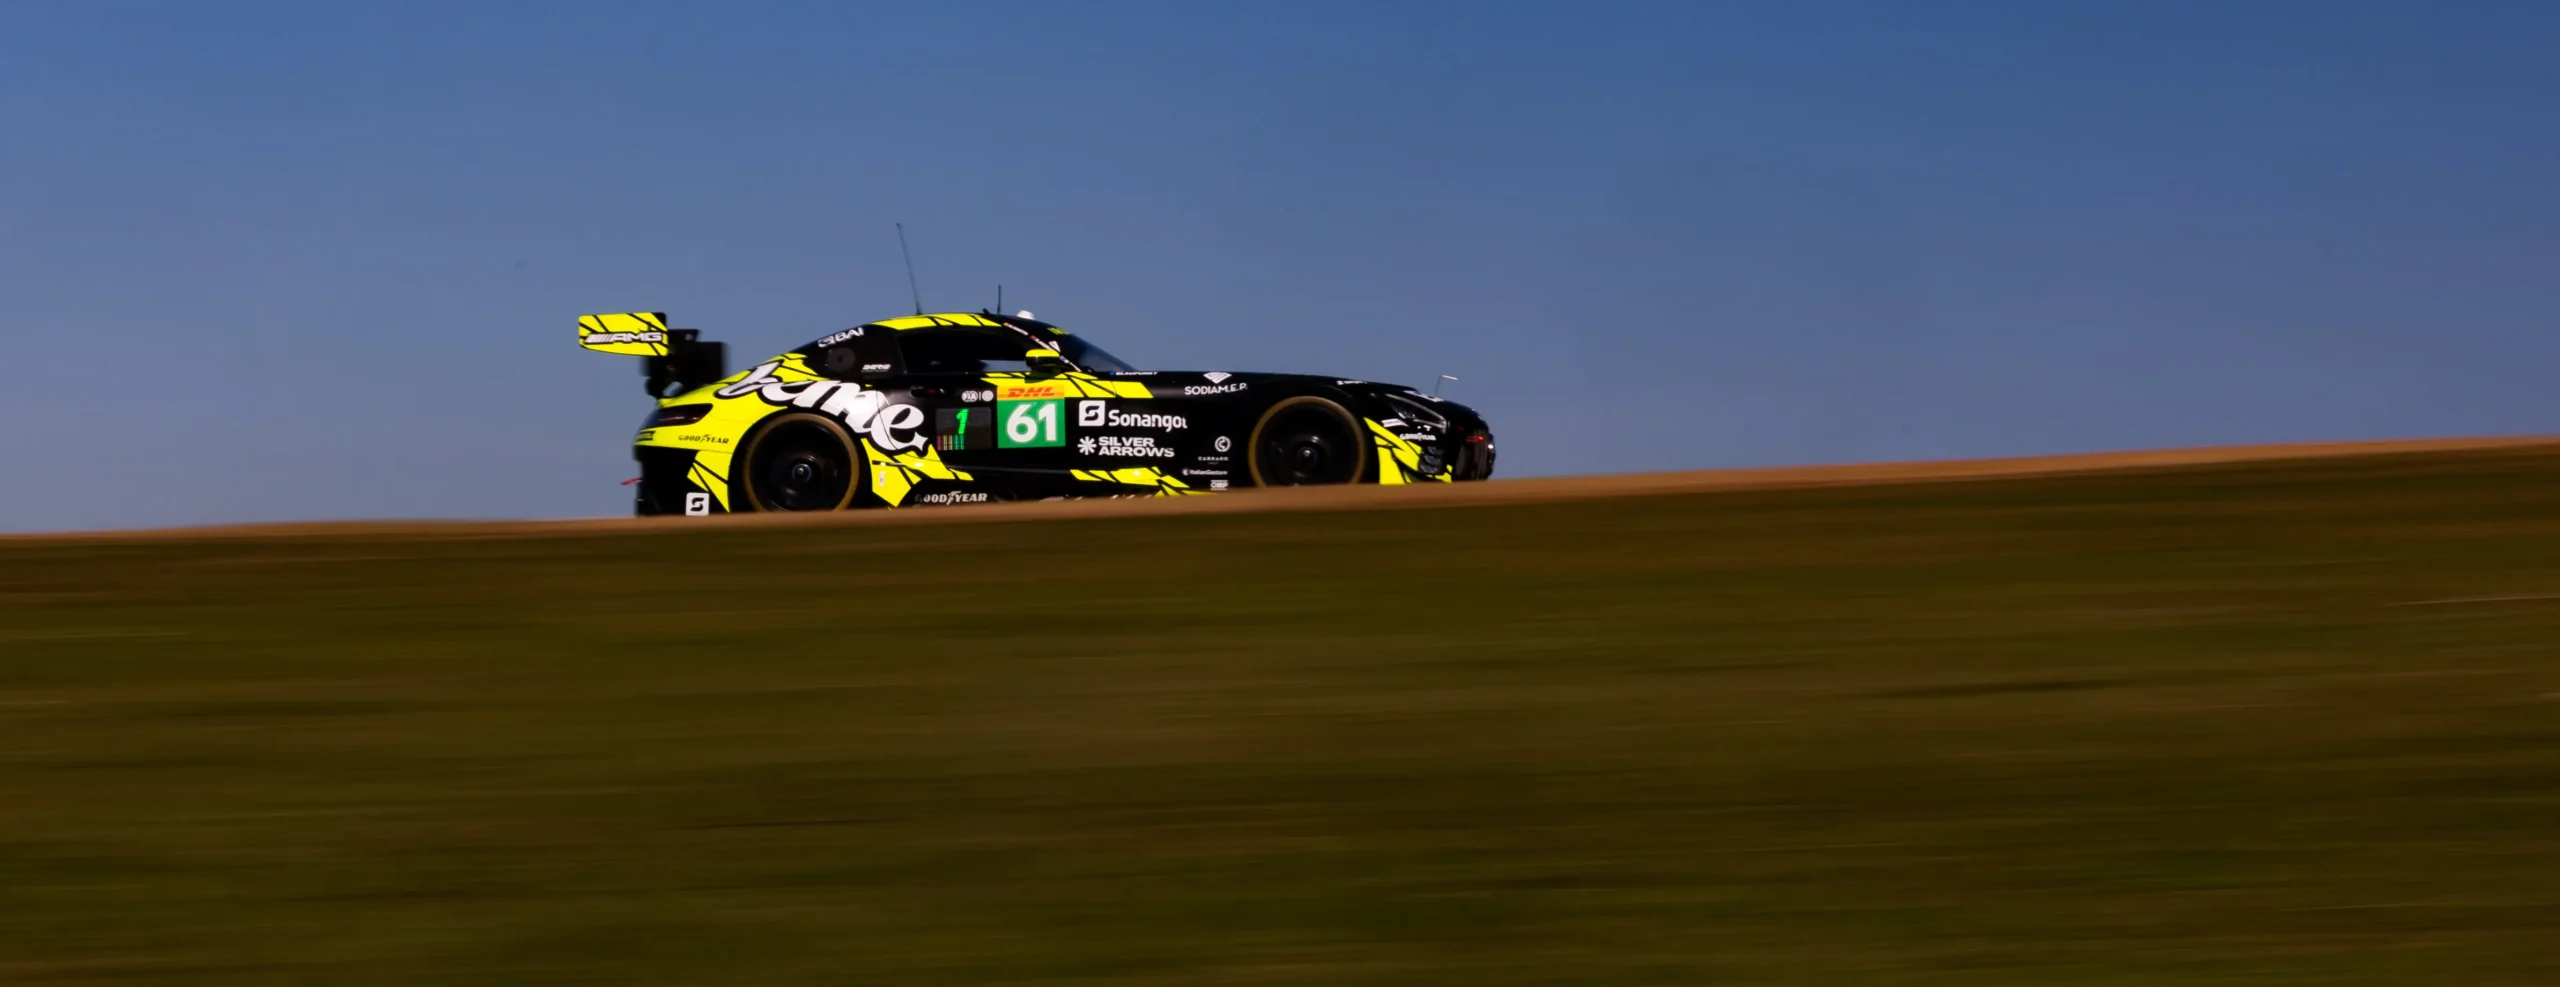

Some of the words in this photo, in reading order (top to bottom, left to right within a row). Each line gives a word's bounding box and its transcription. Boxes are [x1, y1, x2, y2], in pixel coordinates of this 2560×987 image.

[611, 332, 662, 343] AMG
[962, 391, 978, 401] FIA
[1007, 387, 1055, 398] DHL
[956, 408, 969, 435] 1
[1006, 401, 1058, 443] 61
[678, 433, 730, 444] GOODYEAR
[1098, 436, 1155, 447] SILVER
[1098, 447, 1175, 458] ARROWS
